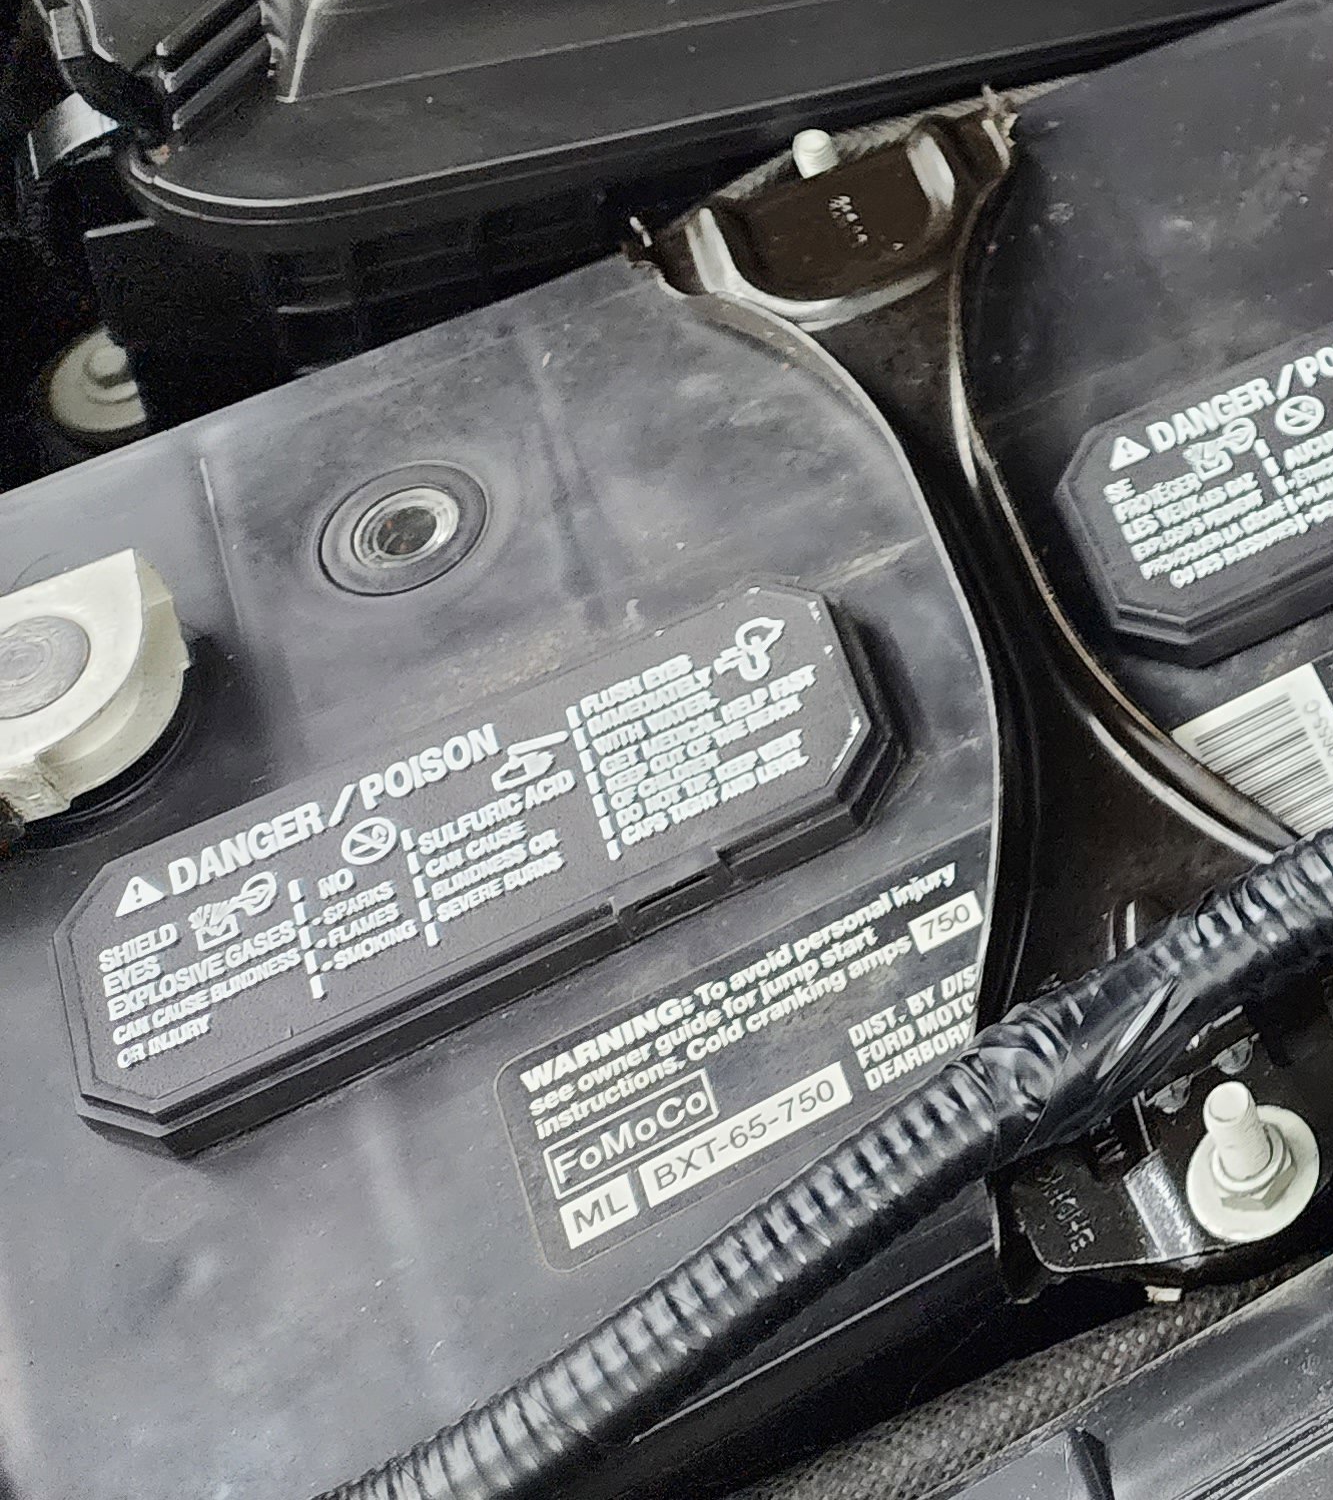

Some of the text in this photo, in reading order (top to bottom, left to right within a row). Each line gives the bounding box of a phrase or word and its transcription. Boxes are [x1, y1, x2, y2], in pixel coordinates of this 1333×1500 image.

[1103, 478, 1135, 504] SE
[1121, 514, 1159, 543] LES
[579, 654, 693, 718] FLUSH EYES
[587, 666, 717, 737] IMMEDIATELY
[592, 720, 646, 756] WITH
[599, 745, 644, 777] GET
[638, 712, 723, 760] MEDICAL
[719, 687, 769, 724] HELP
[650, 745, 686, 775] OUT
[687, 734, 712, 758] OF
[711, 719, 750, 747] THE
[610, 749, 720, 811] OF CHILDREN
[615, 803, 644, 828] DO
[644, 784, 682, 815] NOT
[621, 812, 669, 845] CAPS
[667, 787, 726, 824] TIGHT
[721, 772, 757, 804] AND
[416, 769, 575, 855] SULFURIC ACID
[425, 819, 530, 878] CAN CAUSE
[431, 829, 562, 900] BLINDNESS OR
[317, 867, 354, 899] NO
[321, 880, 396, 925] SPARKS
[436, 851, 565, 922] SEVERE BURNS
[99, 922, 178, 972] SHIELD
[326, 901, 402, 948] FLAMES
[330, 918, 420, 969] SMOKING
[103, 954, 162, 997] EYES
[107, 918, 302, 1021] EXPLOSIVE GASES
[112, 947, 302, 1045] CAN CAUSE BLINDNESS
[520, 863, 955, 1092] WARNING: To avoid personal injury
[529, 926, 878, 1116] see owner guide for jump start
[535, 900, 974, 1139] instructions. Cold cranking amps 750
[847, 962, 983, 1047] DIST. BY DIS
[117, 1013, 217, 1069] OR INJURY
[855, 1024, 915, 1069] FORD
[547, 1082, 712, 1185] FoMoCo
[565, 1076, 841, 1234] ML BXT-65-750
